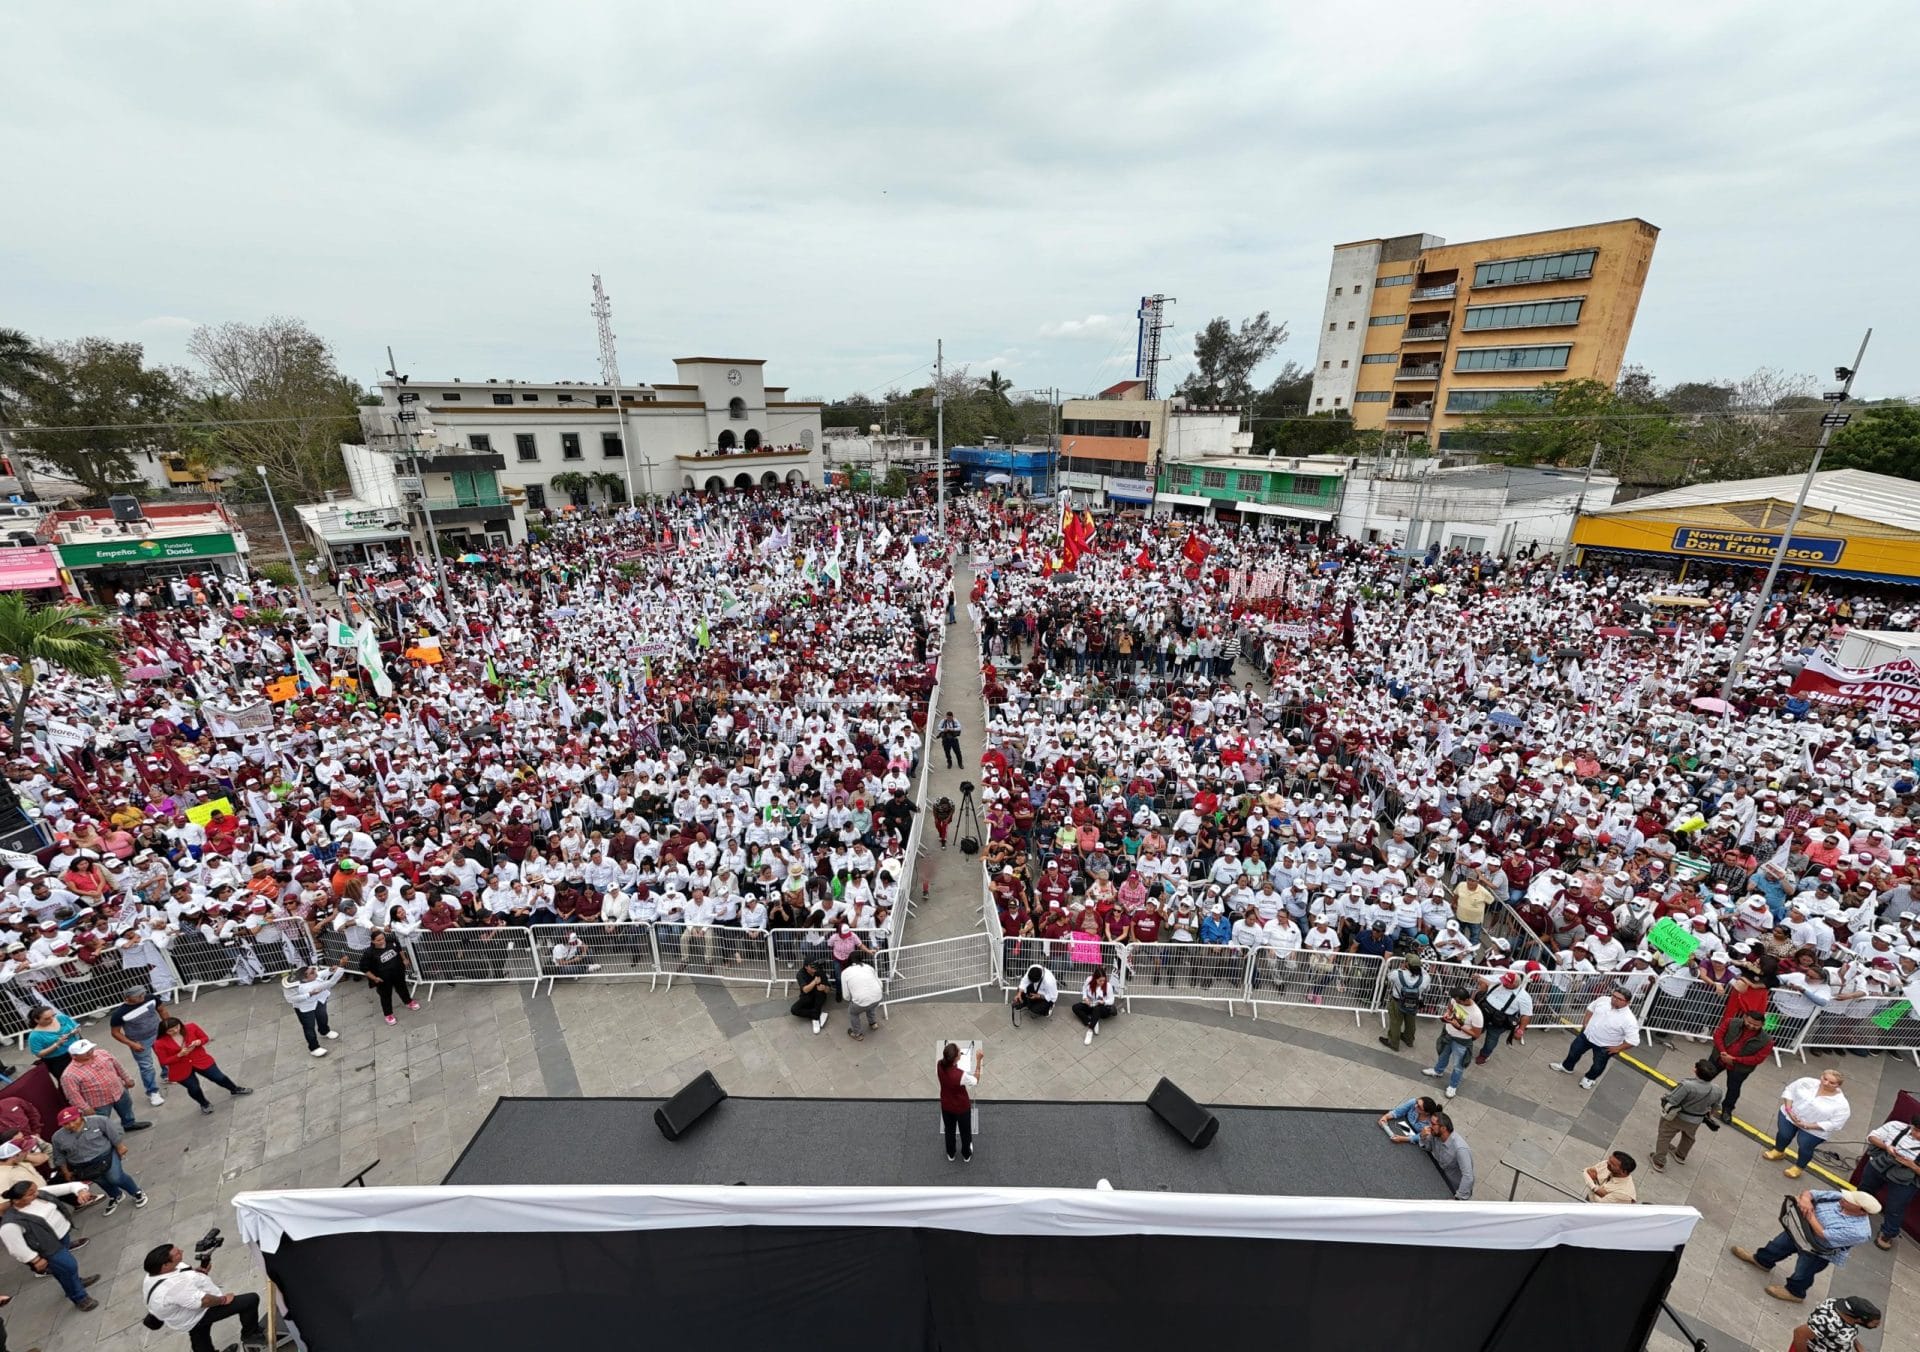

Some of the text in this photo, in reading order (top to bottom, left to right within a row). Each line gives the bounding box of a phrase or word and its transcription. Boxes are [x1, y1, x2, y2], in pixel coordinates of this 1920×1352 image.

[1145, 467, 1154, 475] 24
[1688, 530, 1771, 545] Novedades
[96, 548, 137, 558] Empeños
[165, 547, 195, 556] Dondé
[1684, 538, 1824, 560] Don Francsco
[1838, 684, 1920, 706] CLAUDI
